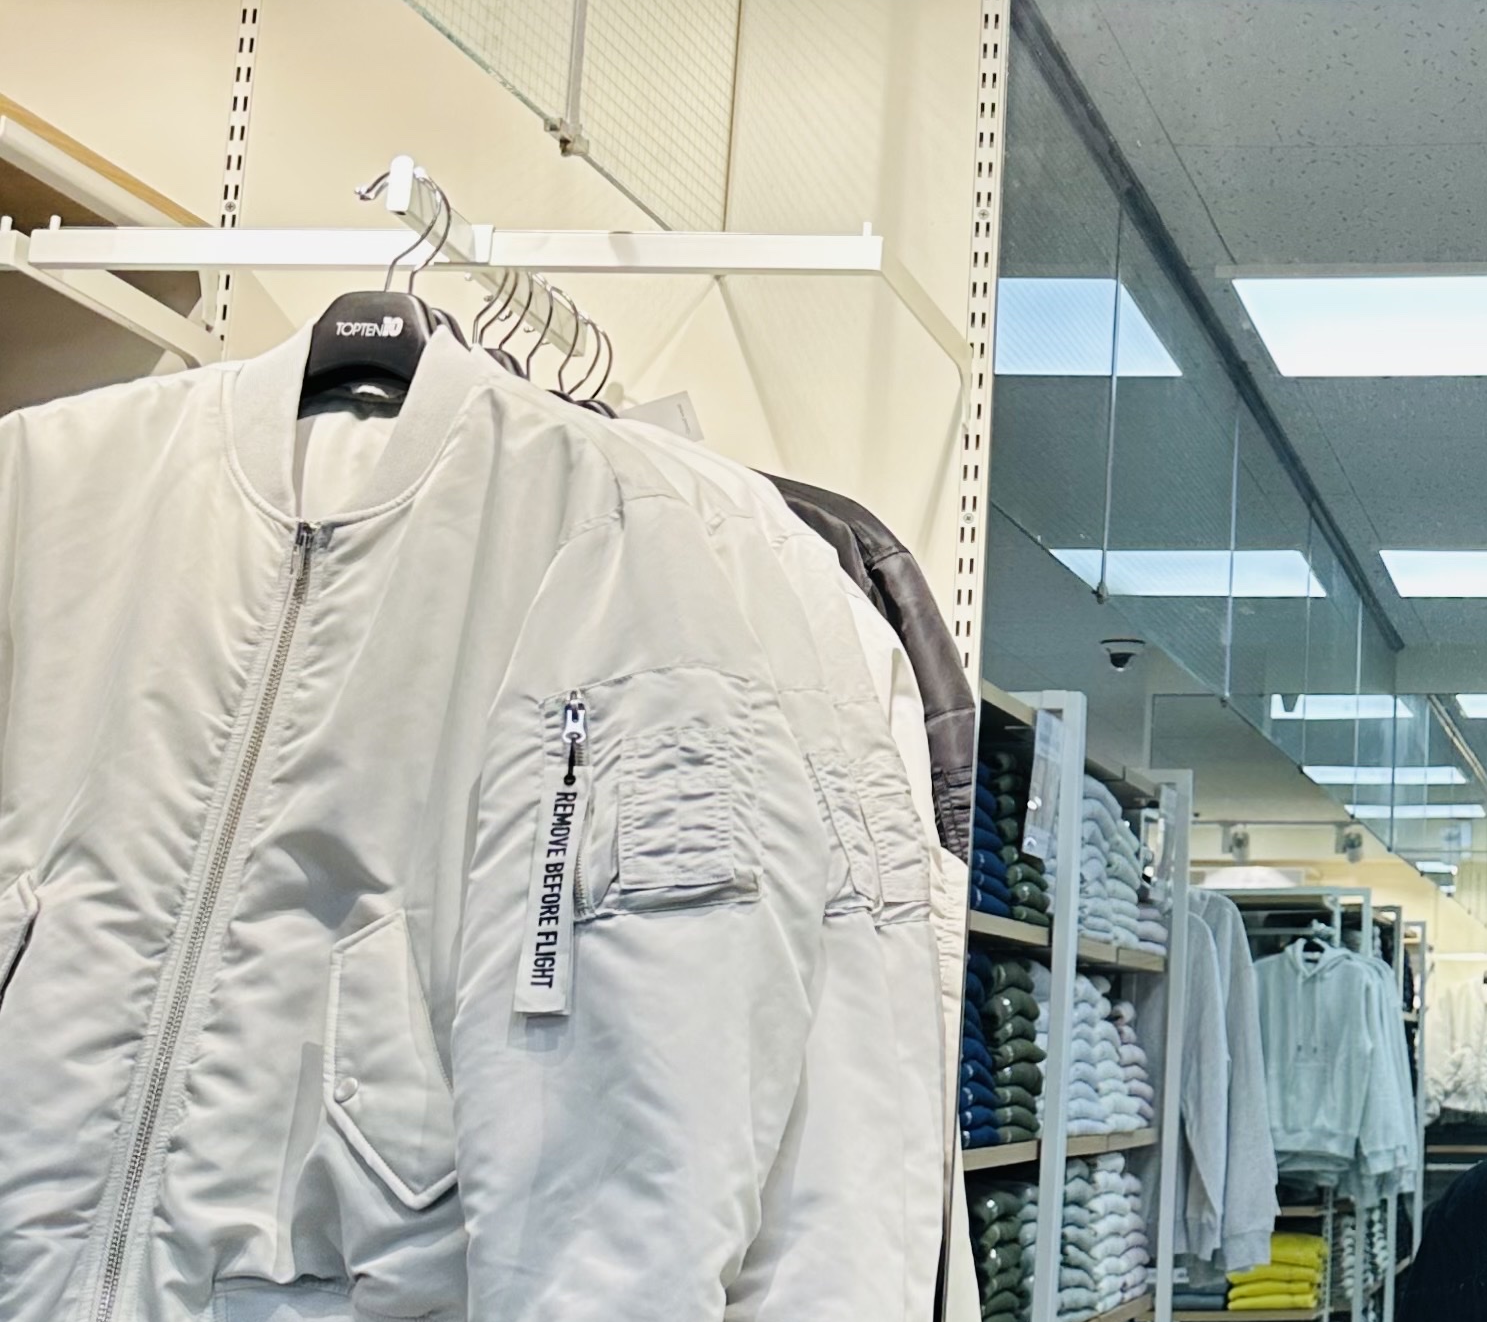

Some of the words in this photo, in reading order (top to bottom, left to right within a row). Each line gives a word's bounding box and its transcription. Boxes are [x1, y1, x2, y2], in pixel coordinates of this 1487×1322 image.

[546, 791, 578, 859] REMOVE
[538, 862, 565, 927] BEFORE
[530, 930, 558, 989] FLIGHT
